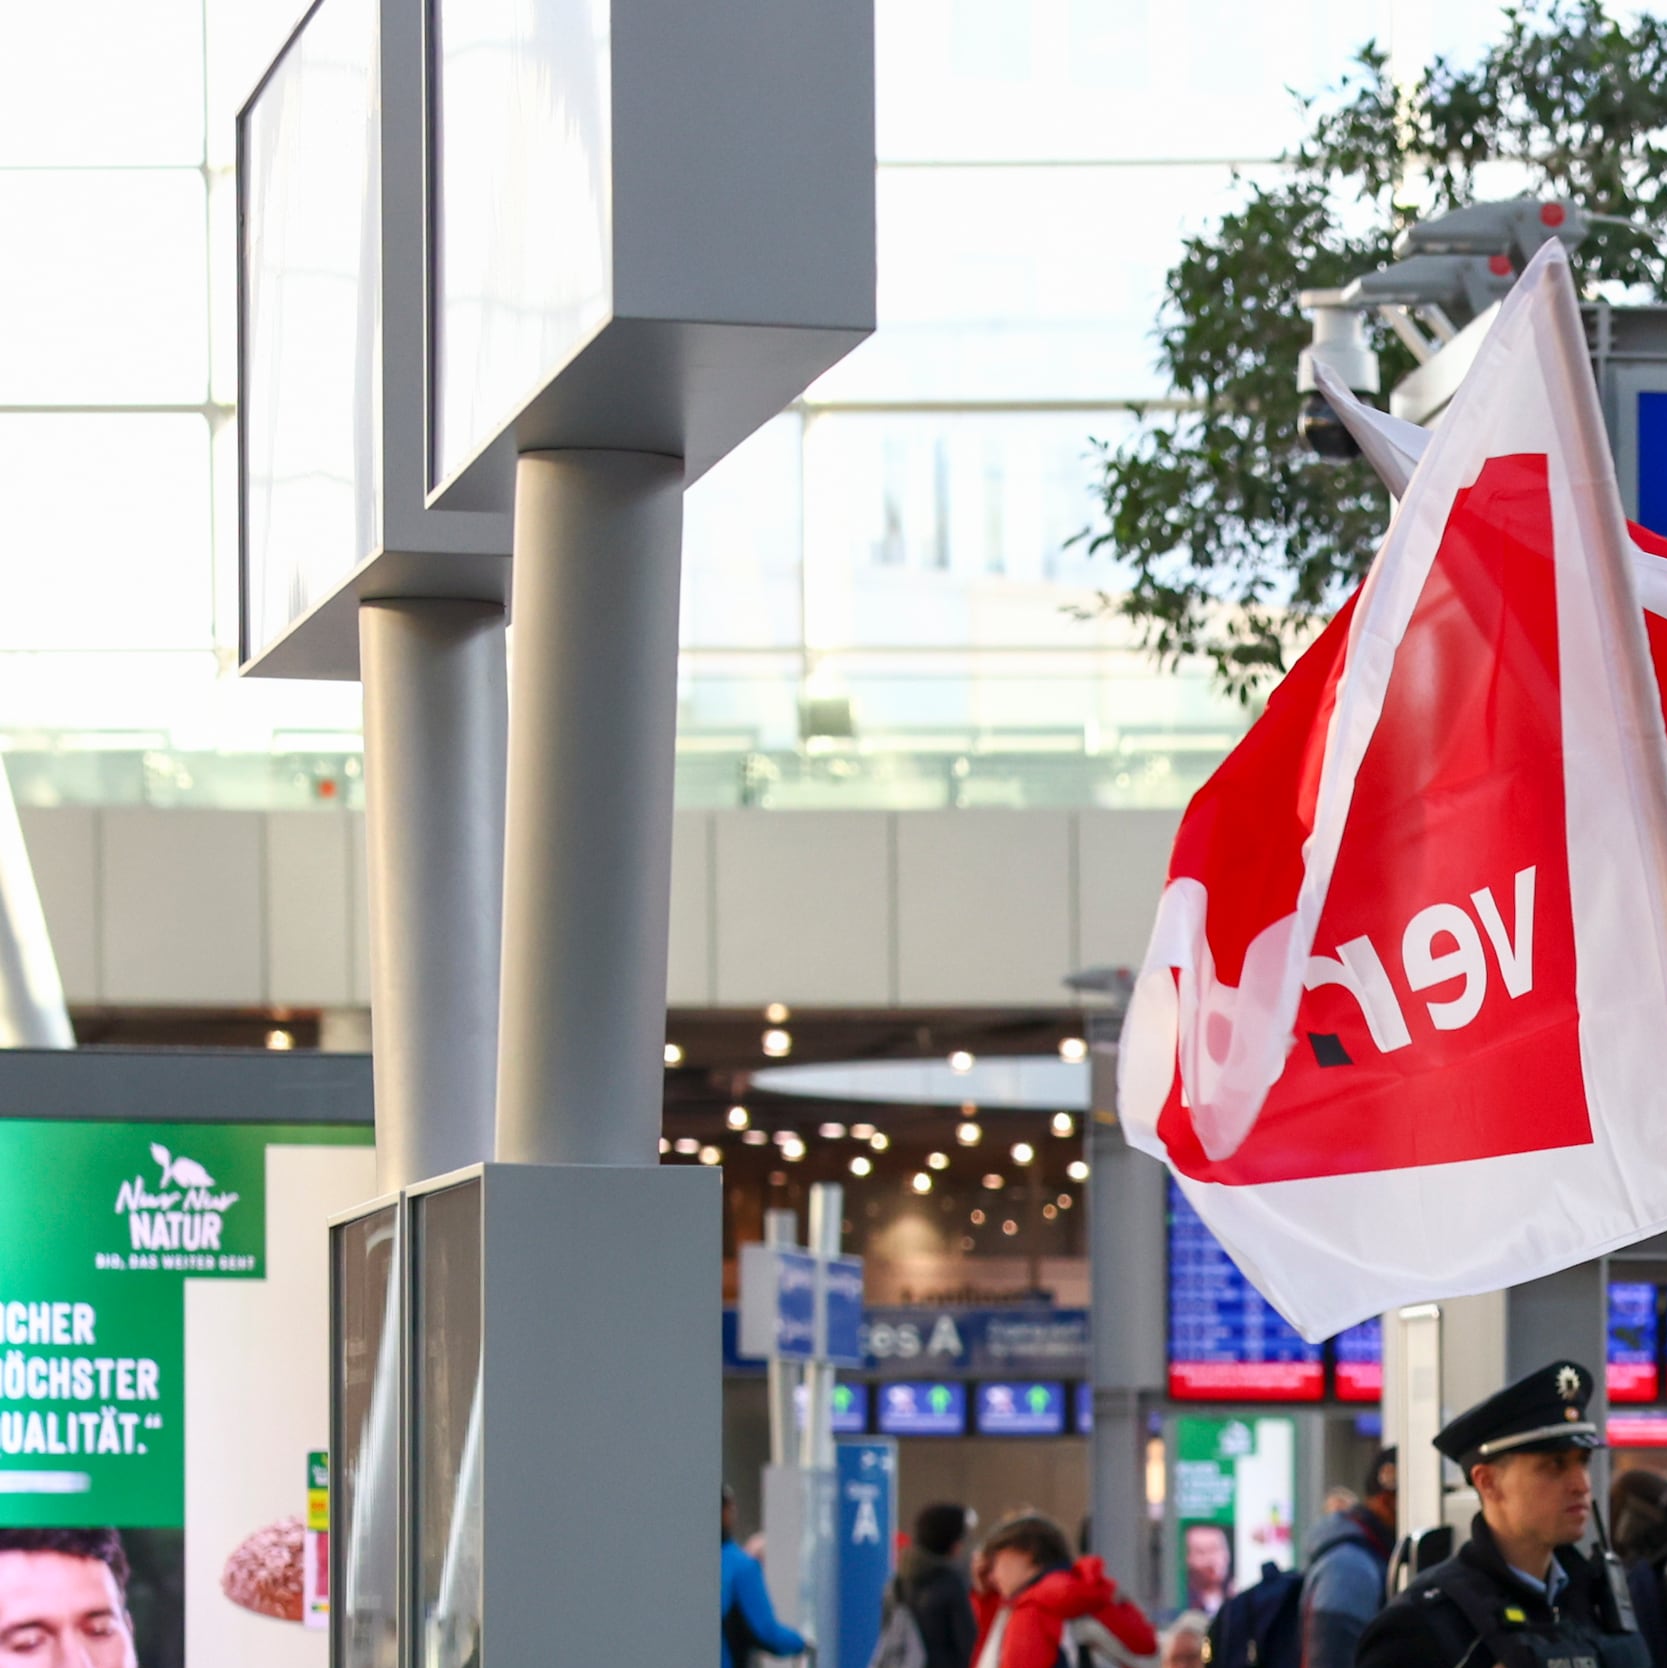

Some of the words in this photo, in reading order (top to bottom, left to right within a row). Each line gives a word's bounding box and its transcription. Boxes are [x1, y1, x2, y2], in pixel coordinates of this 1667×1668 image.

[129, 1212, 223, 1250] NATUR
[928, 1313, 964, 1358] A
[0, 1350, 160, 1400] ÖCHSTER
